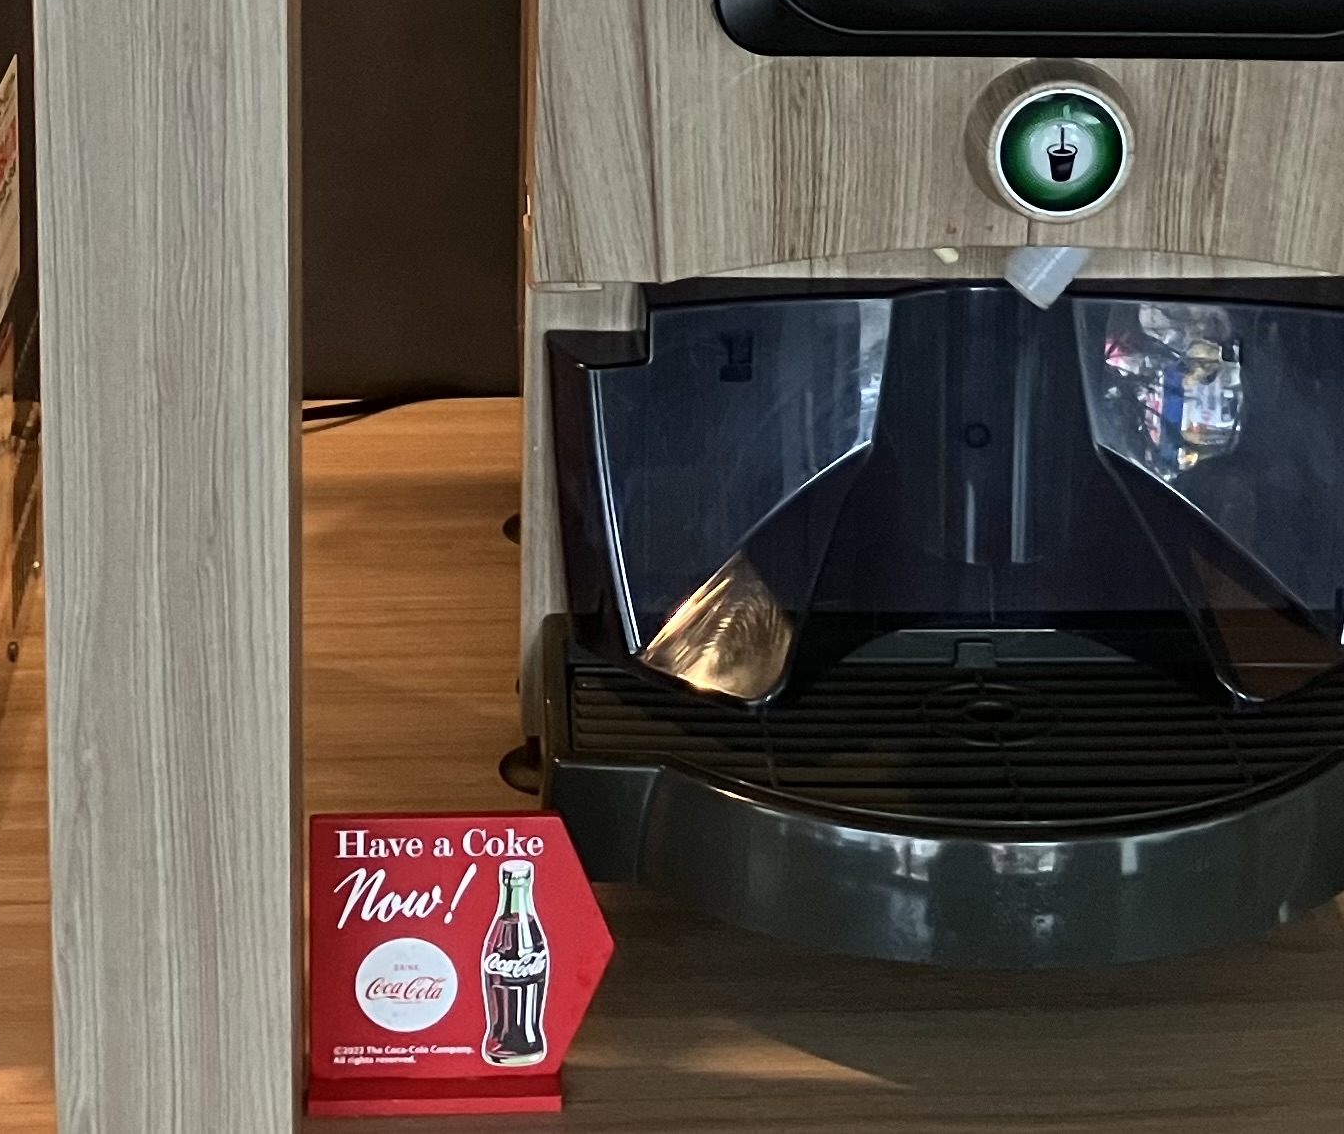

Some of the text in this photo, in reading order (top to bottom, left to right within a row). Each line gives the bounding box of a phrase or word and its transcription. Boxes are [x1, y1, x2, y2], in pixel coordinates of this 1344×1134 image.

[333, 828, 544, 859] Have a Coke
[333, 863, 477, 929] Now!
[393, 963, 420, 972] DRINK
[366, 1046, 384, 1055] The
[384, 1045, 429, 1055] Coca-Cola
[430, 1045, 475, 1055] Company.
[332, 1055, 417, 1066] All rights reserved.
